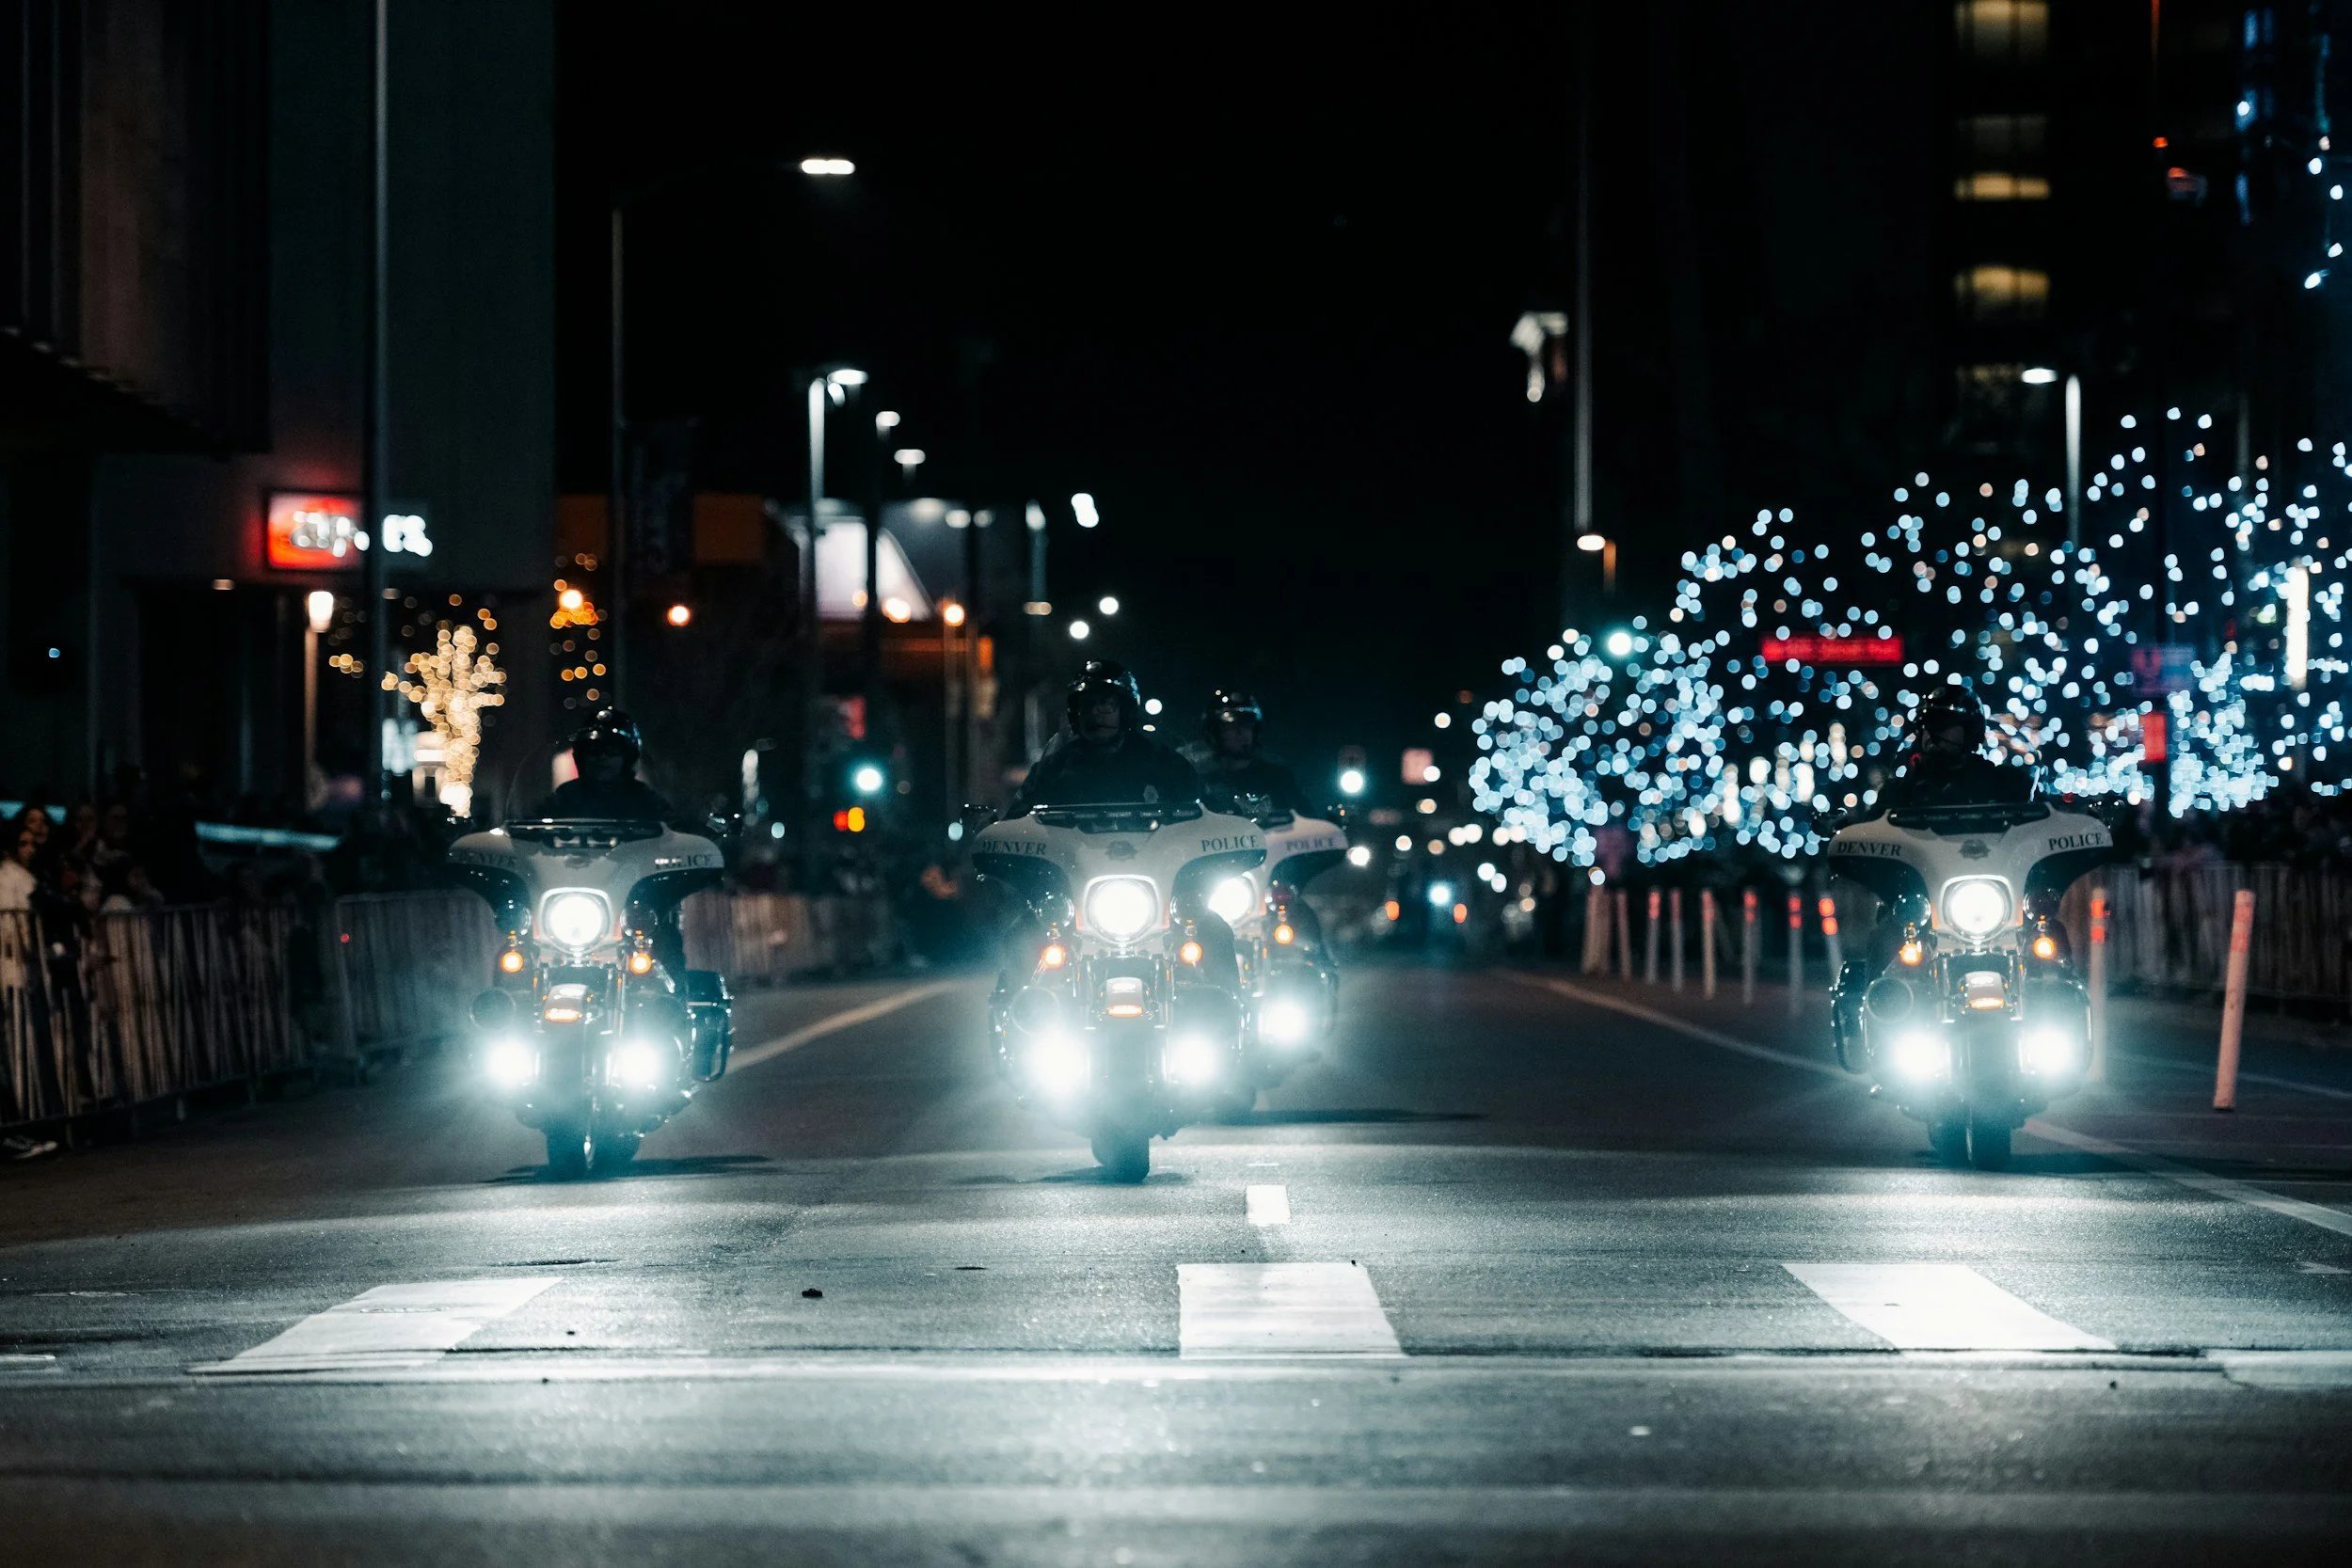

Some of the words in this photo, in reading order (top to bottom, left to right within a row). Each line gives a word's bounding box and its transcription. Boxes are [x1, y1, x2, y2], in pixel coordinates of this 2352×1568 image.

[981, 840, 1047, 855] DENVER
[1201, 834, 1259, 852] POLICE
[1836, 840, 1901, 856] DENVER
[2048, 832, 2105, 850] POLICE
